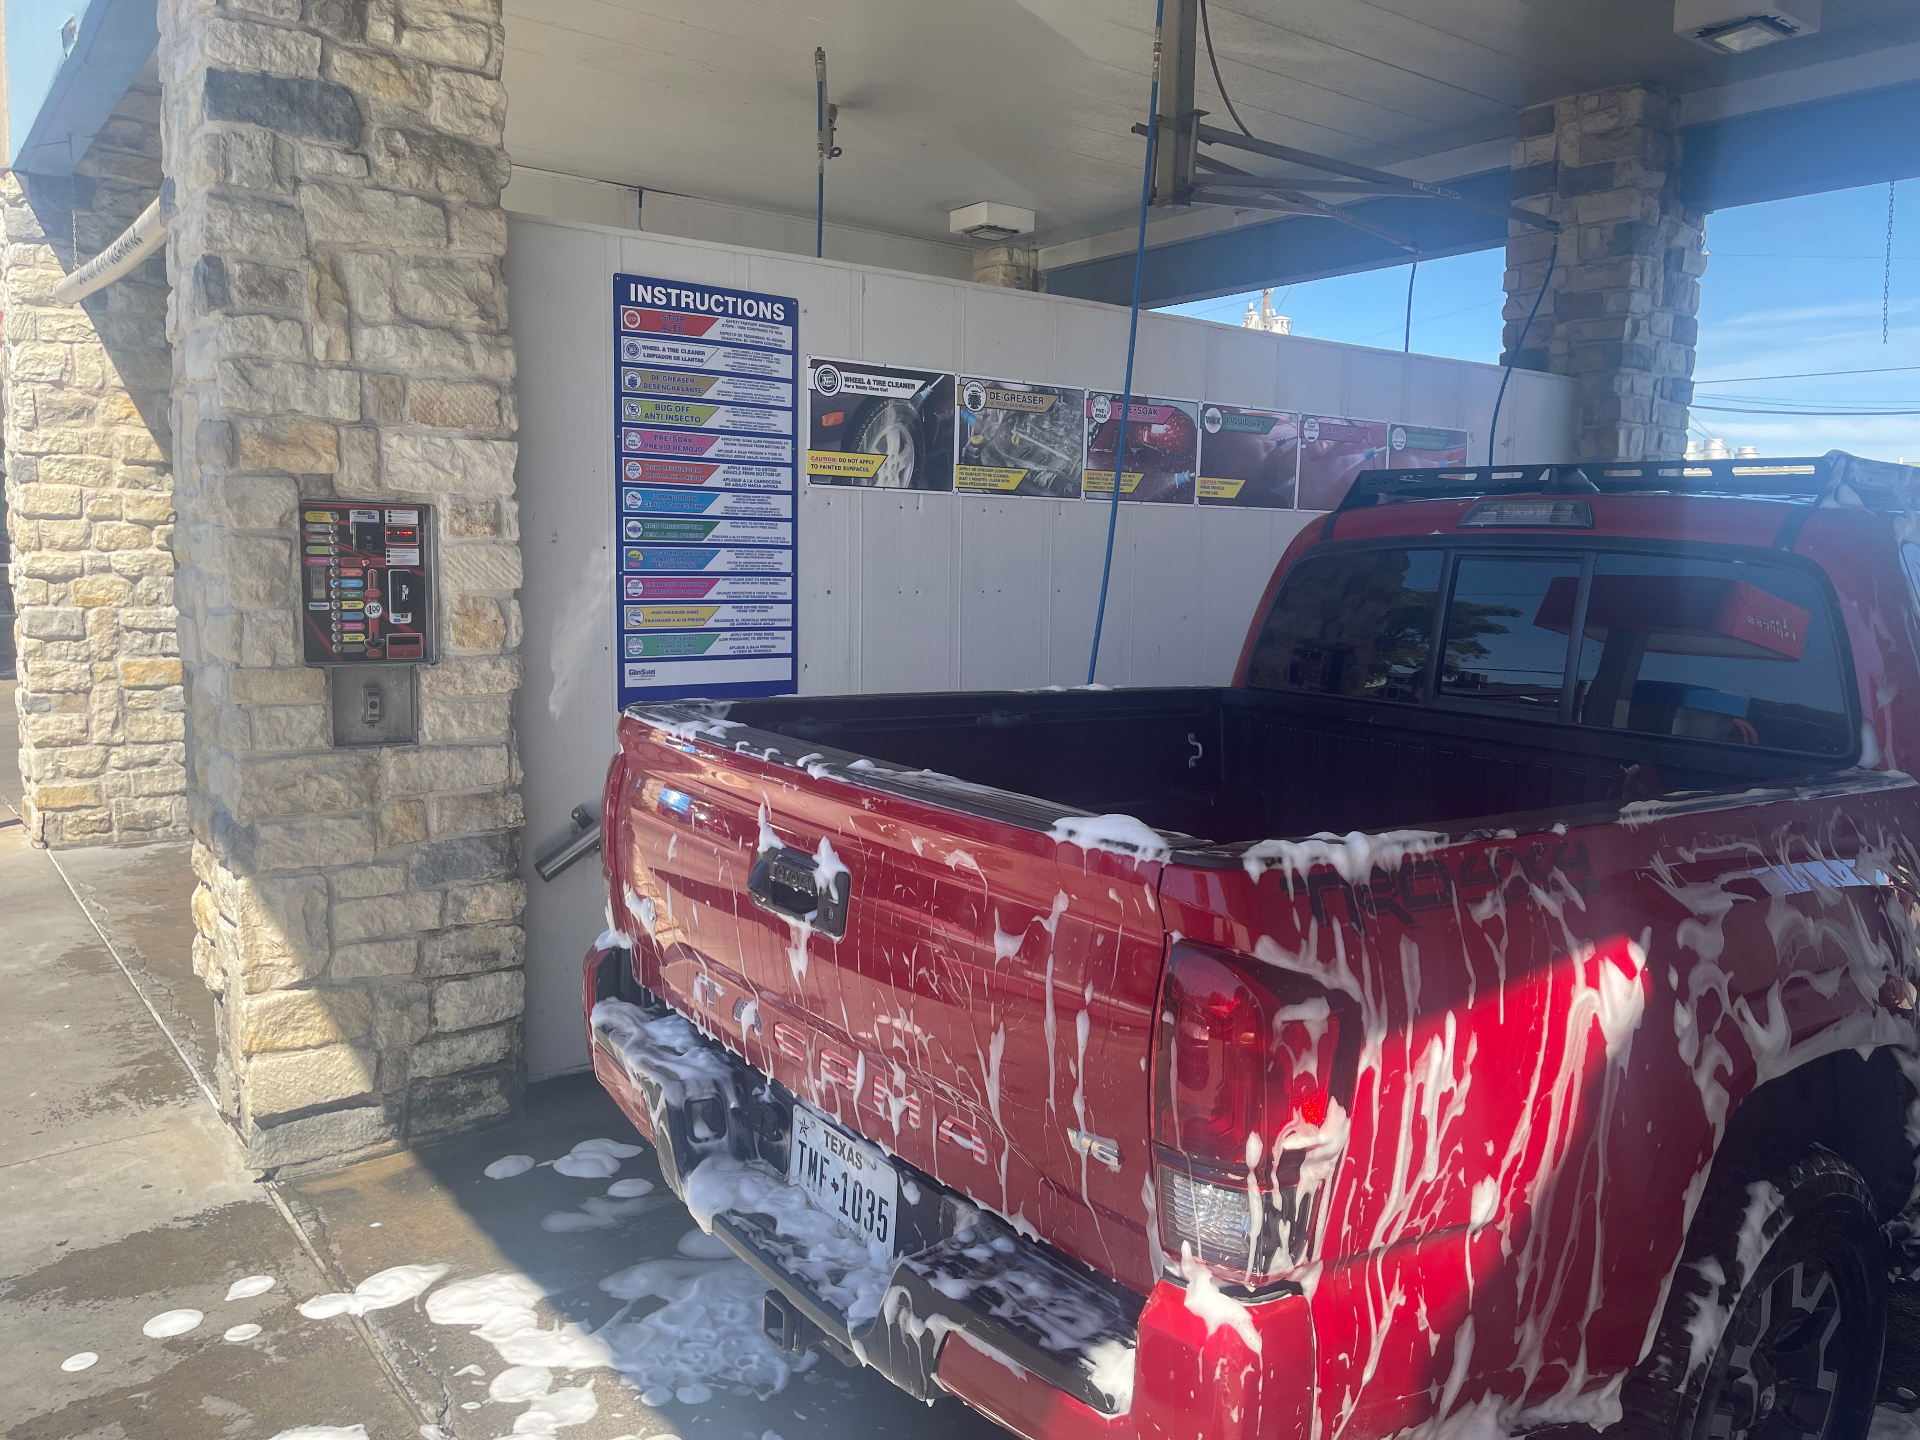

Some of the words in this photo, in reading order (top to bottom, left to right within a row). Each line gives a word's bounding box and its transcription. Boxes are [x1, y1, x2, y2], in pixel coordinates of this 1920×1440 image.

[630, 283, 785, 321] INSTRUCTIONS
[661, 314, 685, 322] STOP
[661, 324, 685, 332] ALTO
[643, 383, 702, 393] DESENGRASANTE
[844, 376, 865, 385] WHEEL
[873, 379, 886, 387] TIRE
[887, 381, 916, 390] CLEANER
[990, 391, 1044, 405] DE-GREASER
[655, 404, 672, 412] BUG
[1118, 405, 1158, 415] PE-SOAK
[666, 415, 701, 423] INSECTO
[1227, 416, 1248, 425] LIQUID
[823, 1129, 863, 1171] TEXAS
[1066, 1125, 1122, 1168] V6
[798, 1139, 830, 1198] TMF
[839, 1171, 889, 1243] 1035
